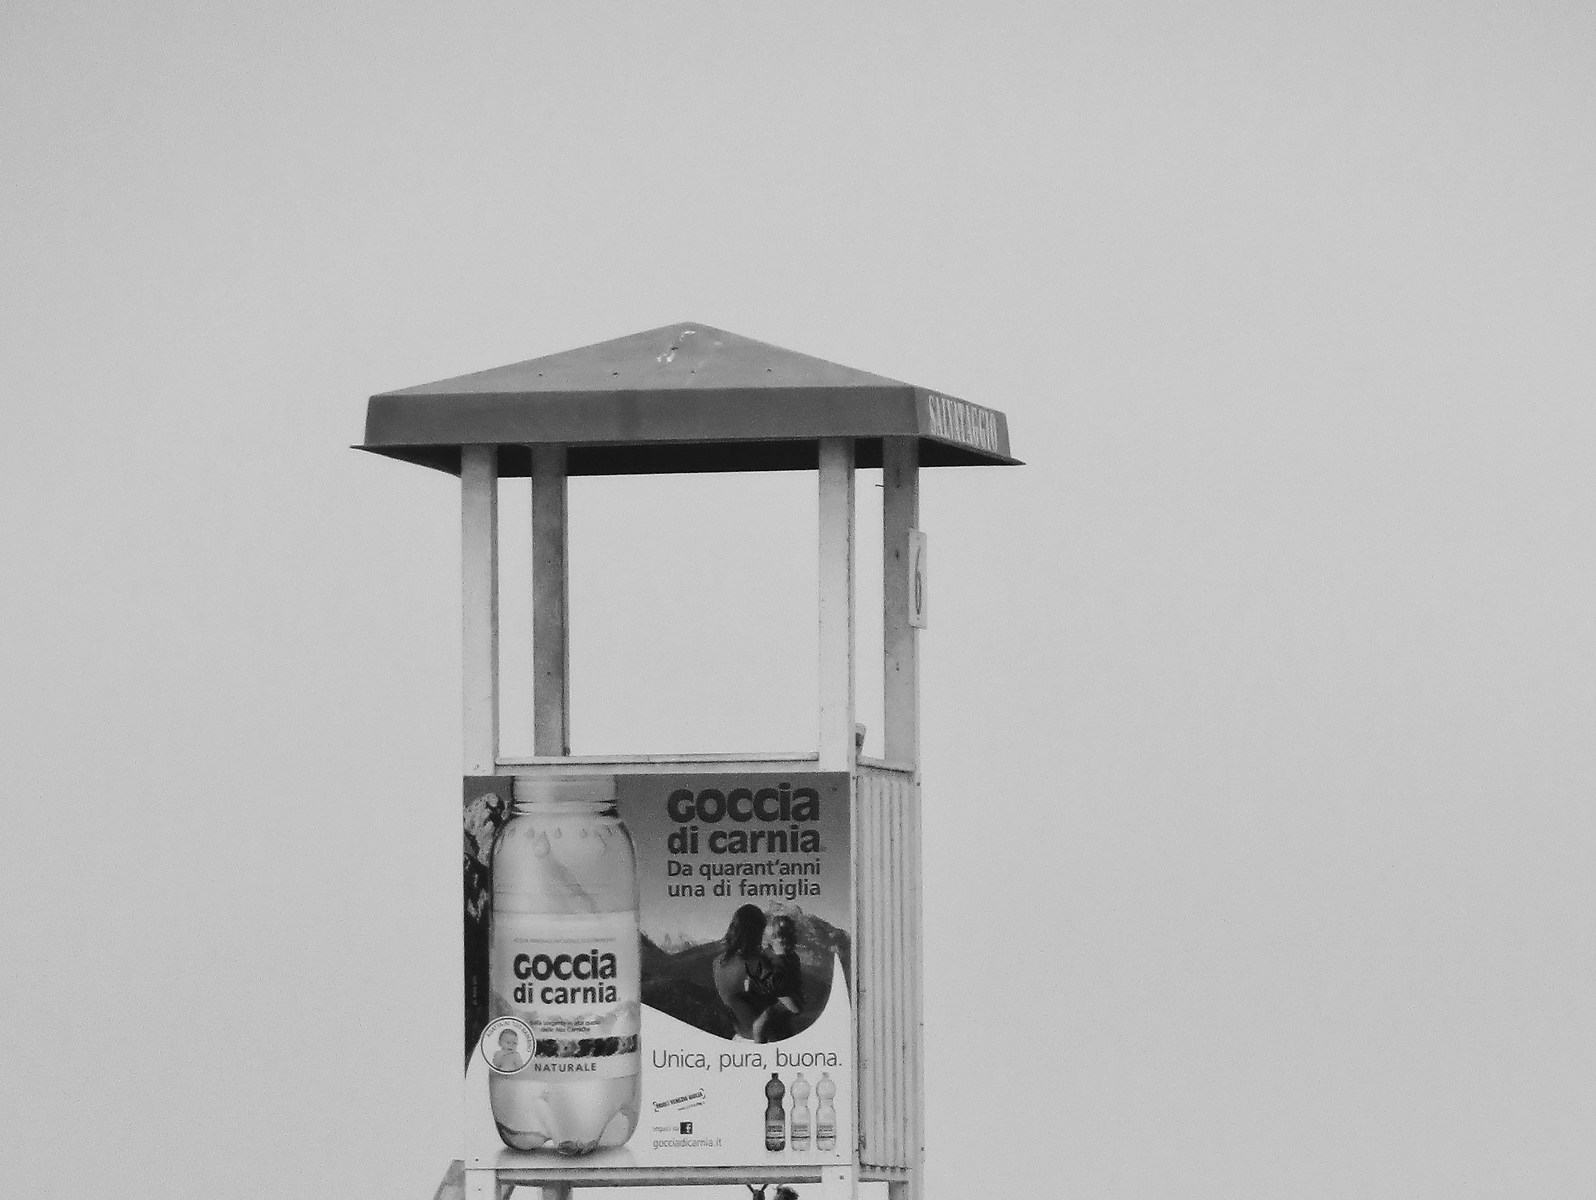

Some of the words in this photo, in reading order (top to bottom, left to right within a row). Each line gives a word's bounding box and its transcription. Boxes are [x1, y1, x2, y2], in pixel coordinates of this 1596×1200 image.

[667, 825, 699, 855] di
[708, 824, 820, 855] carnia
[667, 860, 693, 877] Da
[699, 858, 820, 881] quarant'anni
[667, 883, 705, 898] una
[713, 879, 731, 897] di
[739, 878, 821, 901] famiglia
[513, 982, 533, 1004] di
[540, 981, 617, 1005] carnia
[534, 1062, 597, 1073] NATURALE
[652, 1049, 711, 1071] Unica,
[719, 1052, 768, 1073] pura,
[775, 1047, 843, 1068] buona.
